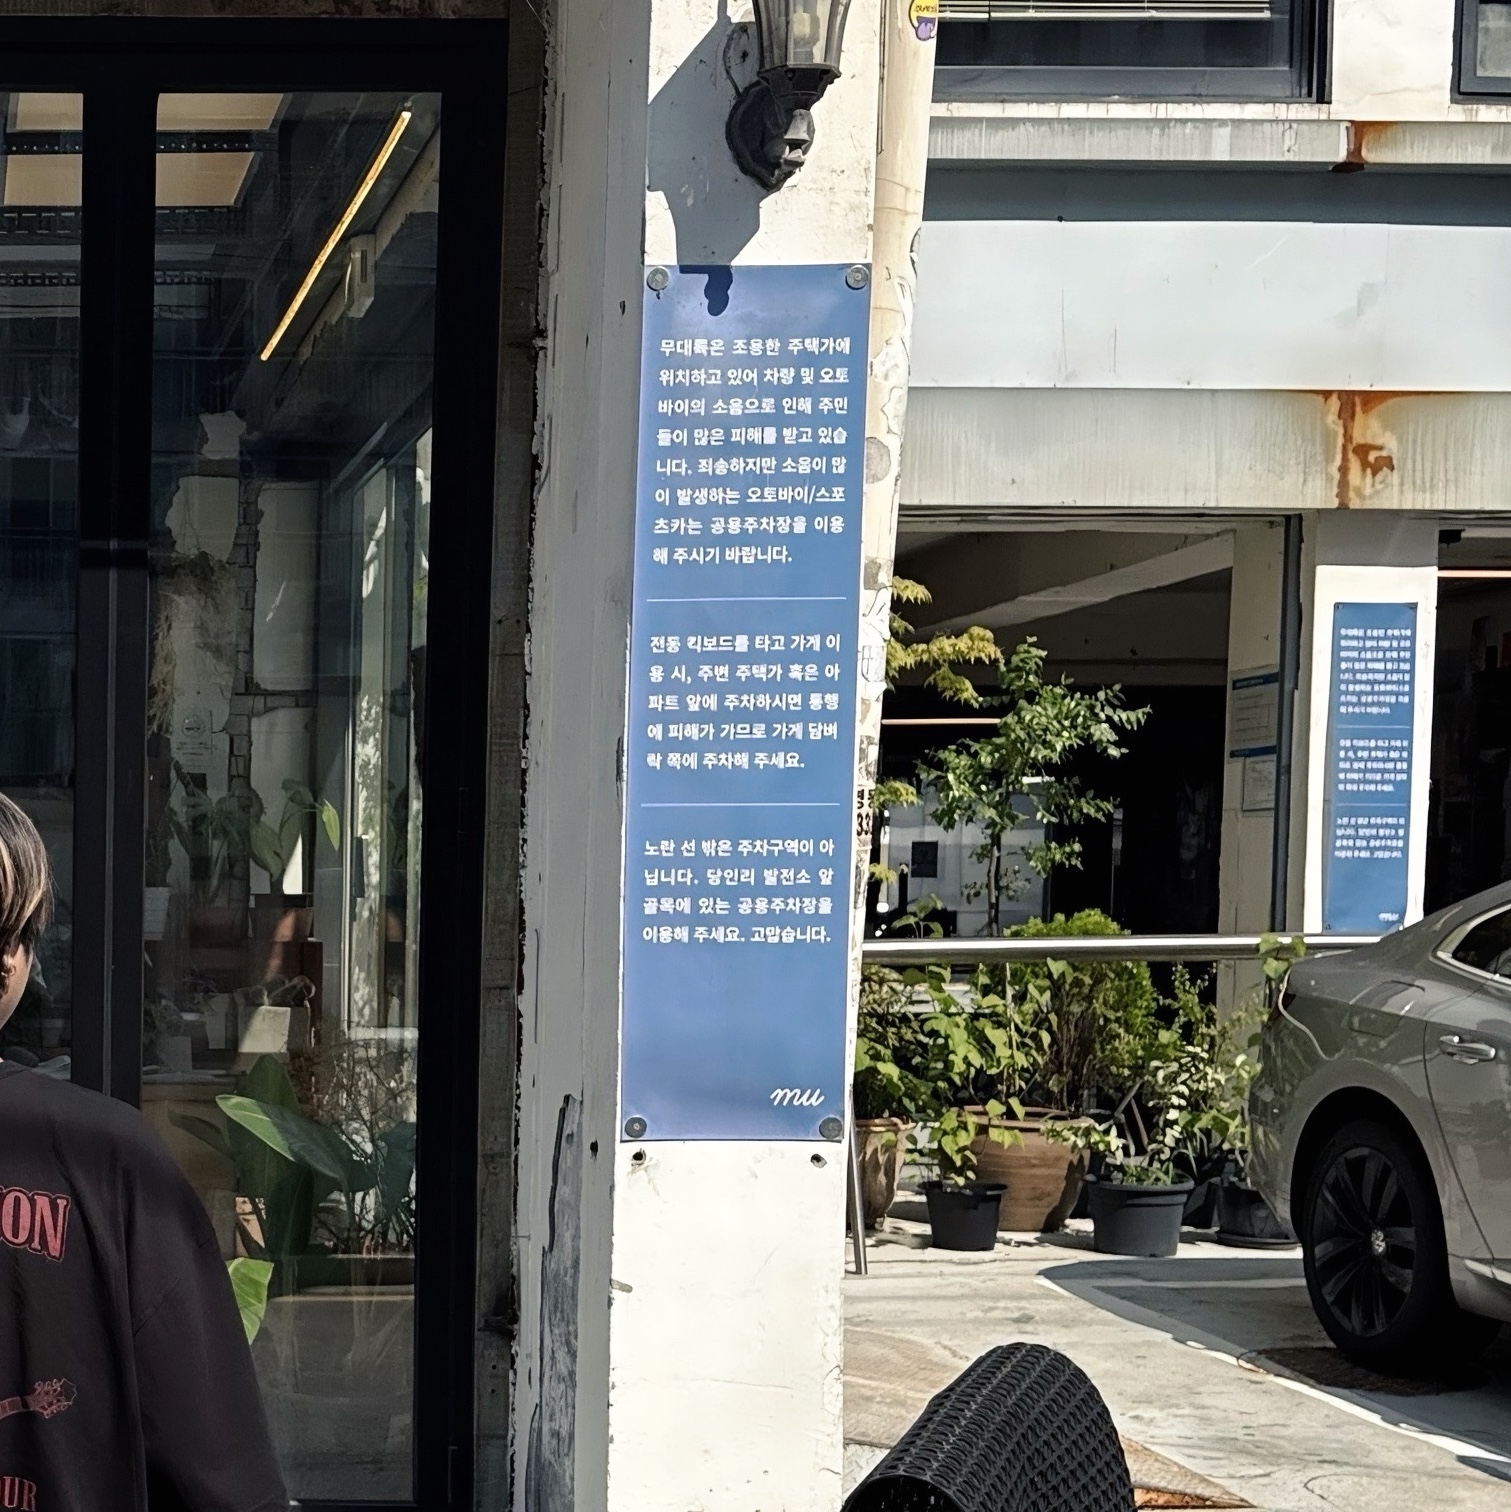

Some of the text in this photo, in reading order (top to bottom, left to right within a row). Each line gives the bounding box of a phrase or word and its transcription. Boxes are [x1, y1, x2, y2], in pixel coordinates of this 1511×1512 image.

[660, 337, 851, 357] 무대륙은 조용한 주택가에
[659, 366, 849, 387] 위치하고 있어 차량 및 오토
[658, 396, 848, 417] 바이의 소음으로 인해 주민
[656, 426, 847, 447] 들이 많은 피해를 받고 있습
[656, 456, 847, 476] 니다. 죄송하지만 소음이 많
[655, 485, 845, 506] 이 발생하는 오토바이/스포
[653, 515, 845, 535] 츠카는 공용주차장을 이용
[652, 545, 792, 565] 해 주시기 바랍니다.
[650, 633, 840, 653] 전동 킥보드를 타고 가게 이
[649, 663, 840, 684] 용 시, 주변 주택가 혹은 아
[648, 692, 839, 712] 파트 앞에 주차하시면 통행
[647, 721, 838, 741] 에 피해가 가므로 가게 담벼
[646, 751, 805, 770] 락 쪽에 주차해 주세요.
[644, 838, 835, 857] 노란 선 밖은 주차구역이 아
[644, 867, 834, 886] 닙니다. 당인리 발전소 앞
[643, 897, 833, 915] 골목에 있는 공용주차장을
[642, 925, 831, 944] 이용해 주세요. 고맙습니다.
[769, 1088, 825, 1107] mu
